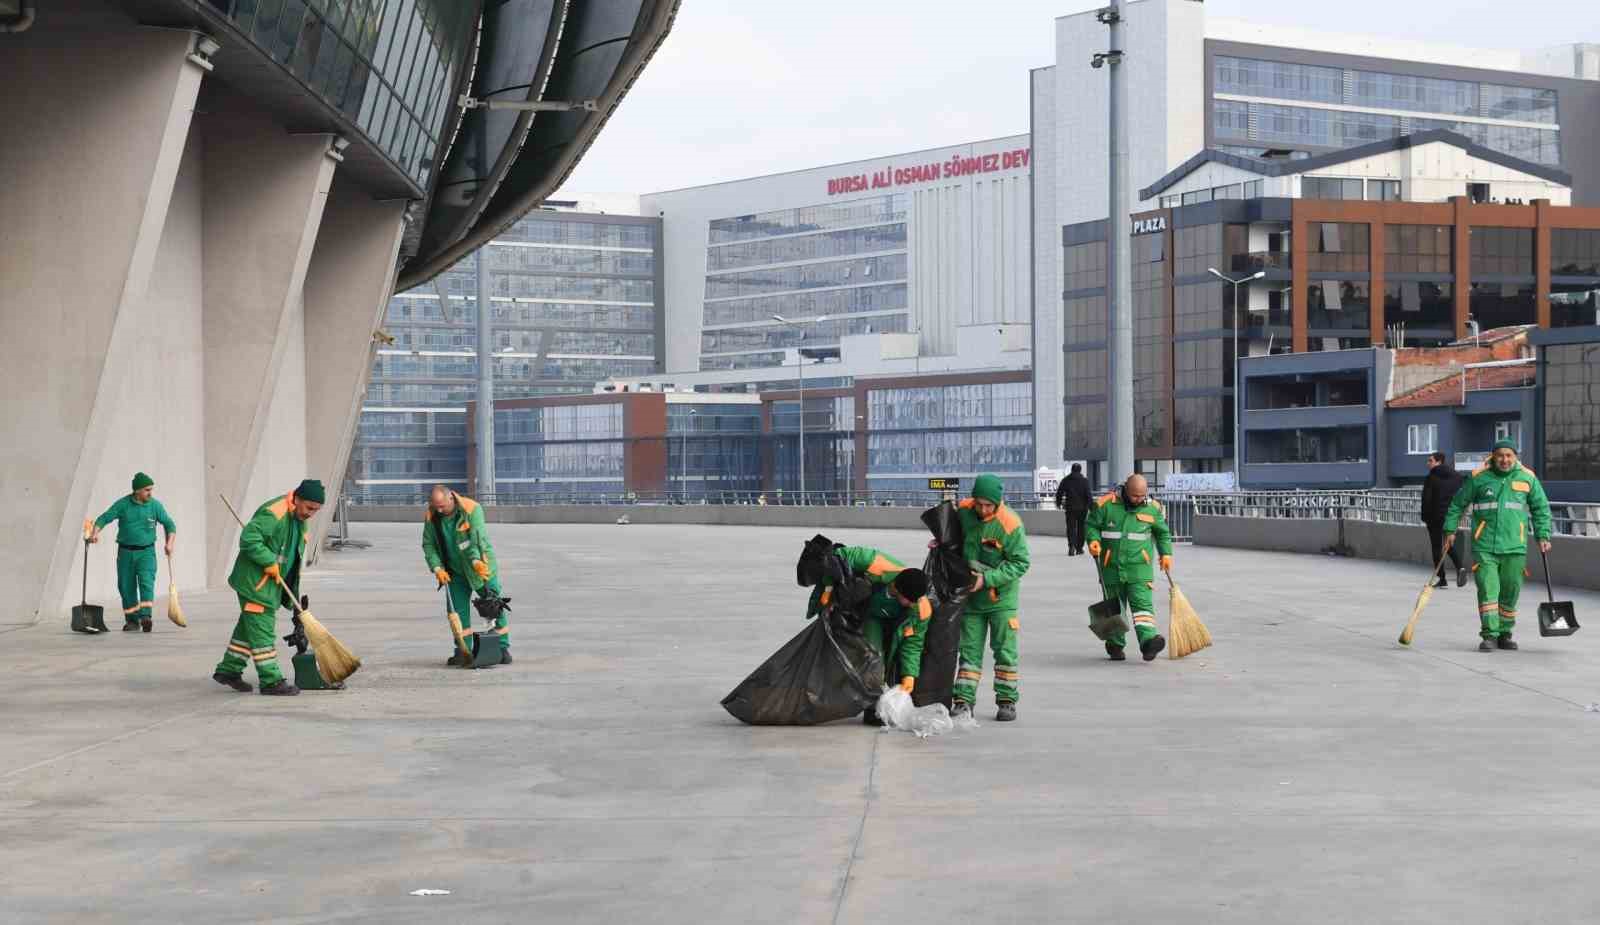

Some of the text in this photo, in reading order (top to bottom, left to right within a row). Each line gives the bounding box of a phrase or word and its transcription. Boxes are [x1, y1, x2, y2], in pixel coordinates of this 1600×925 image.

[827, 149, 1029, 196] BURSA ALİ OSMAN SÖNMEZ DEV
[1134, 217, 1166, 233] PLAZA
